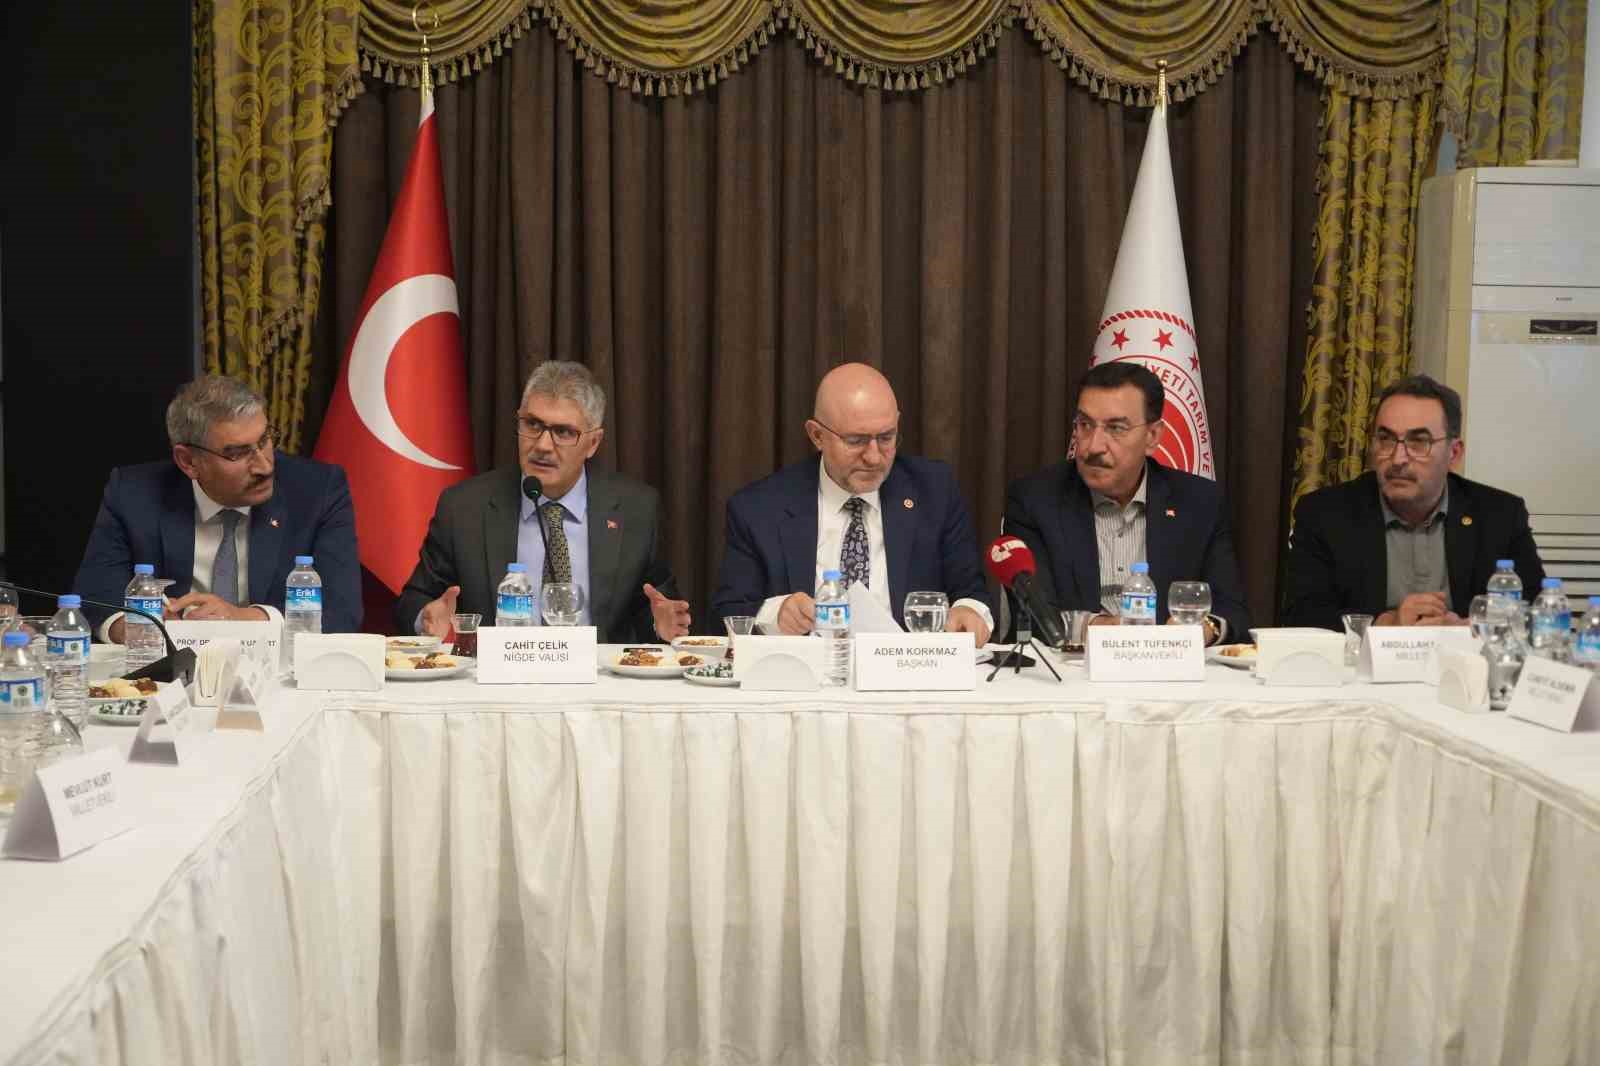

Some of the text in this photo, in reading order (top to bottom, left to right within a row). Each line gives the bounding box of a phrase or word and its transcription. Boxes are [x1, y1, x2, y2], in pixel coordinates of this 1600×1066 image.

[1185, 389, 1208, 444] TARIM
[1202, 452, 1211, 473] VE
[504, 640, 536, 650] CAHİT
[873, 647, 958, 656] ADEM KORKMAZ
